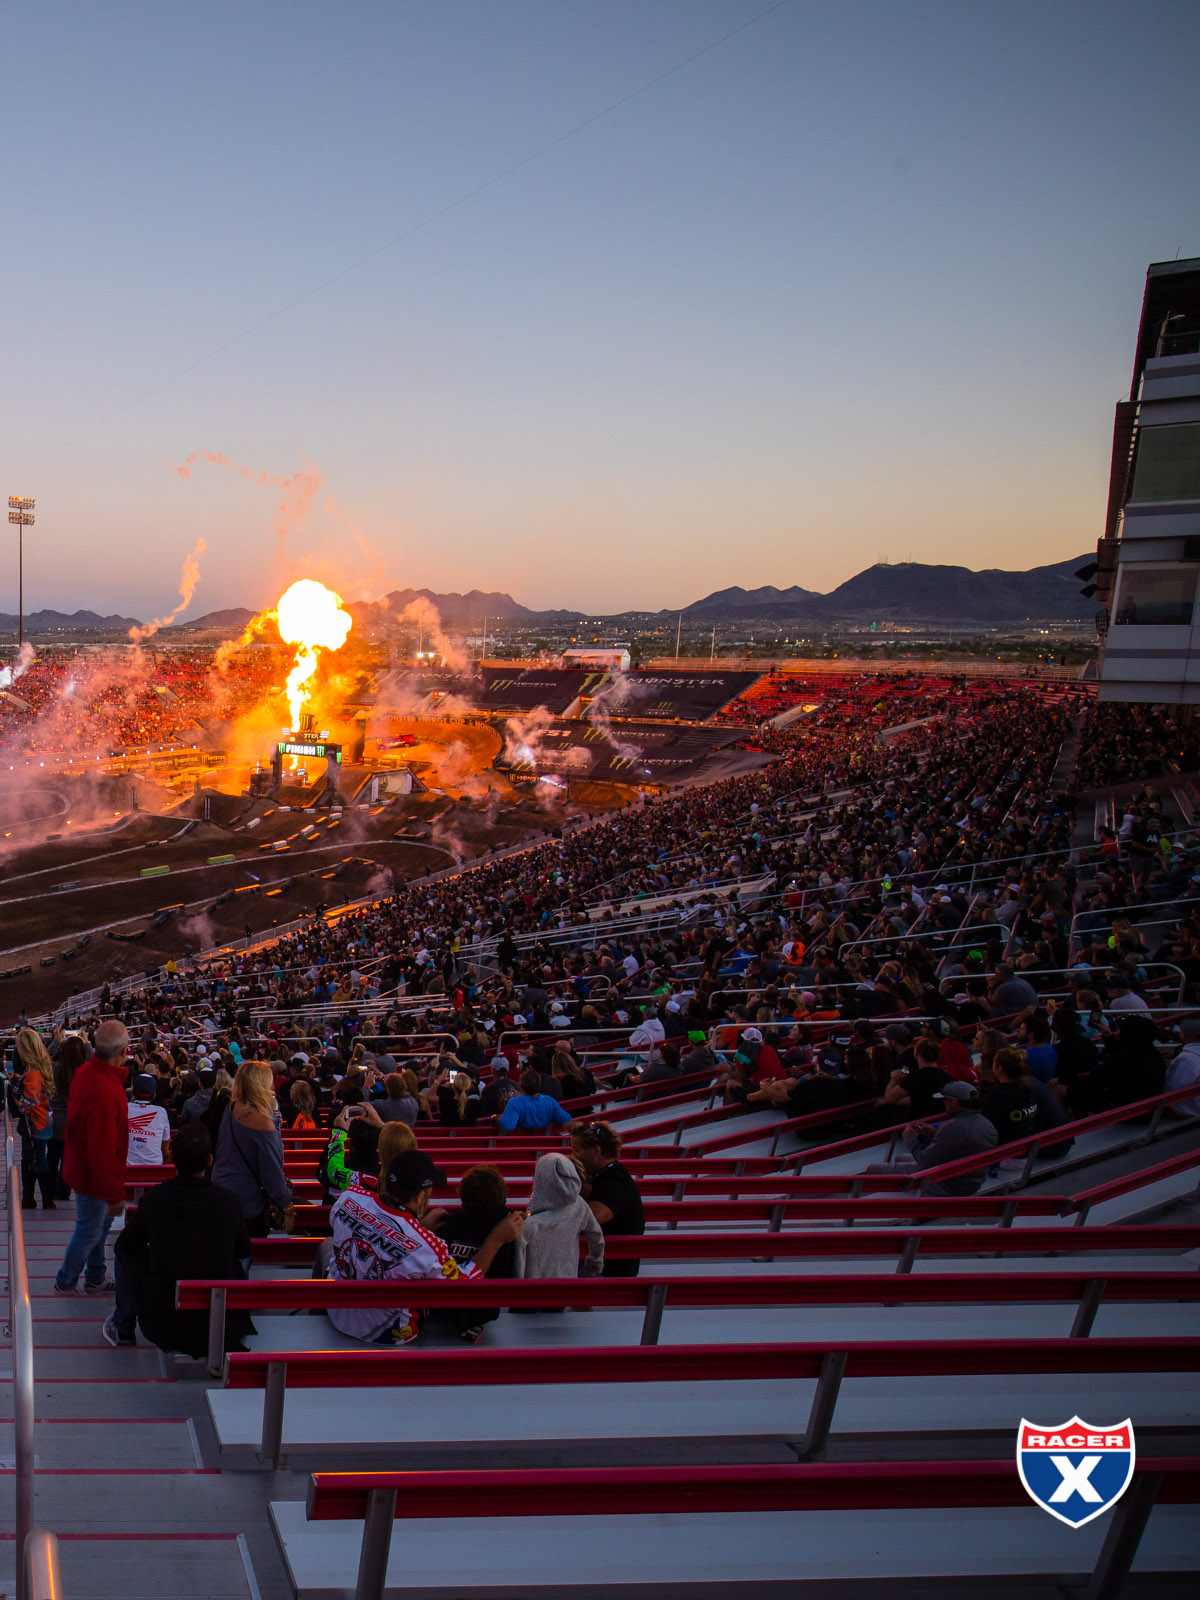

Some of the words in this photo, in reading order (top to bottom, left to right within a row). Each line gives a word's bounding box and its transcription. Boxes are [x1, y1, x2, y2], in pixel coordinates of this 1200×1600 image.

[628, 677, 725, 686] MONSTER
[285, 744, 316, 756] FINISH
[335, 1208, 410, 1260] RACING
[342, 1198, 422, 1253] EXOTICS
